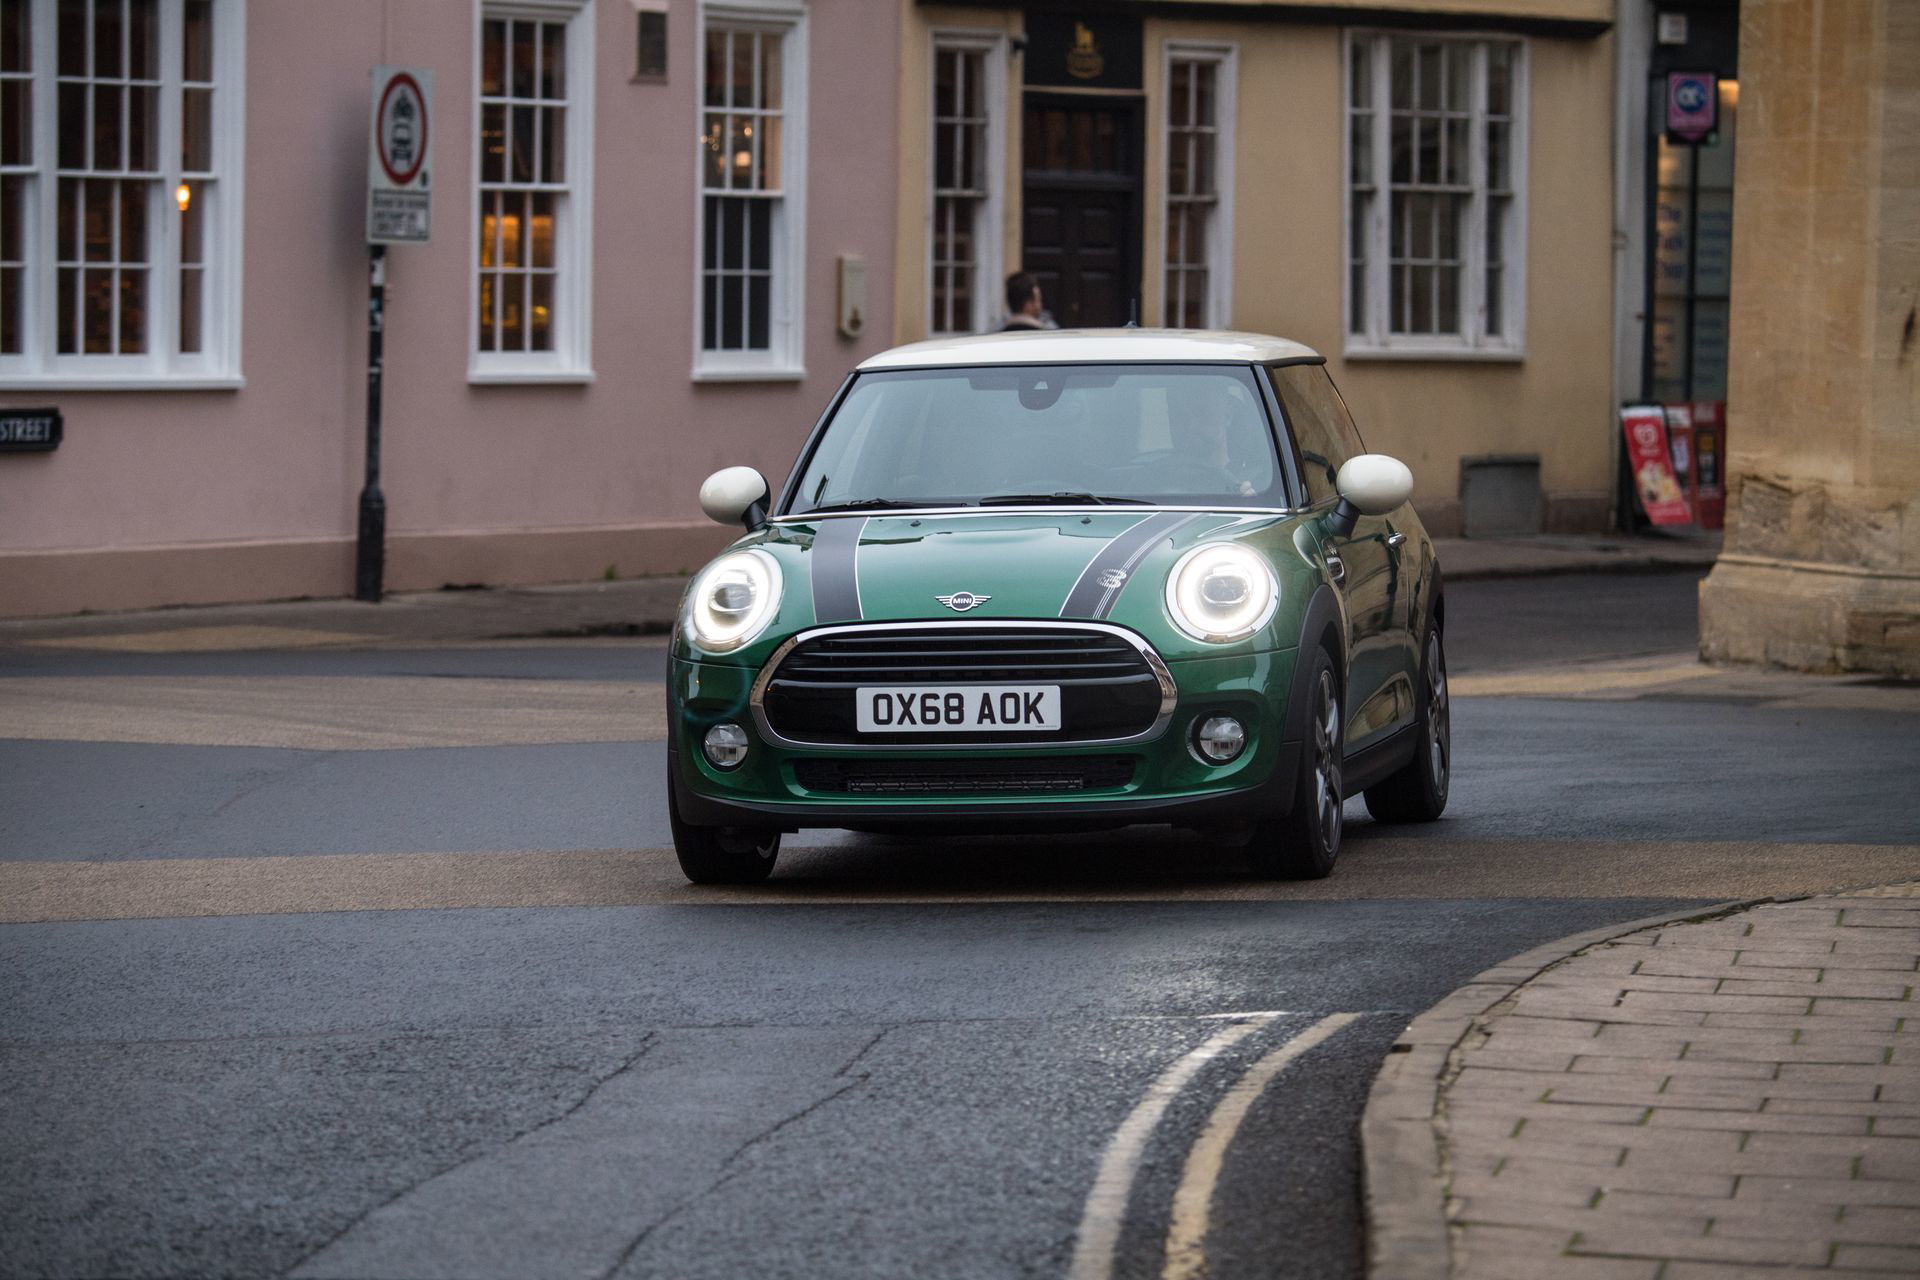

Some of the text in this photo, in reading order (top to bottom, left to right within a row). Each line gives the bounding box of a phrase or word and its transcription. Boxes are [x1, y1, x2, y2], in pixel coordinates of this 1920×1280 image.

[0, 417, 52, 441] STREET
[873, 692, 1045, 725] OX68 AOK
